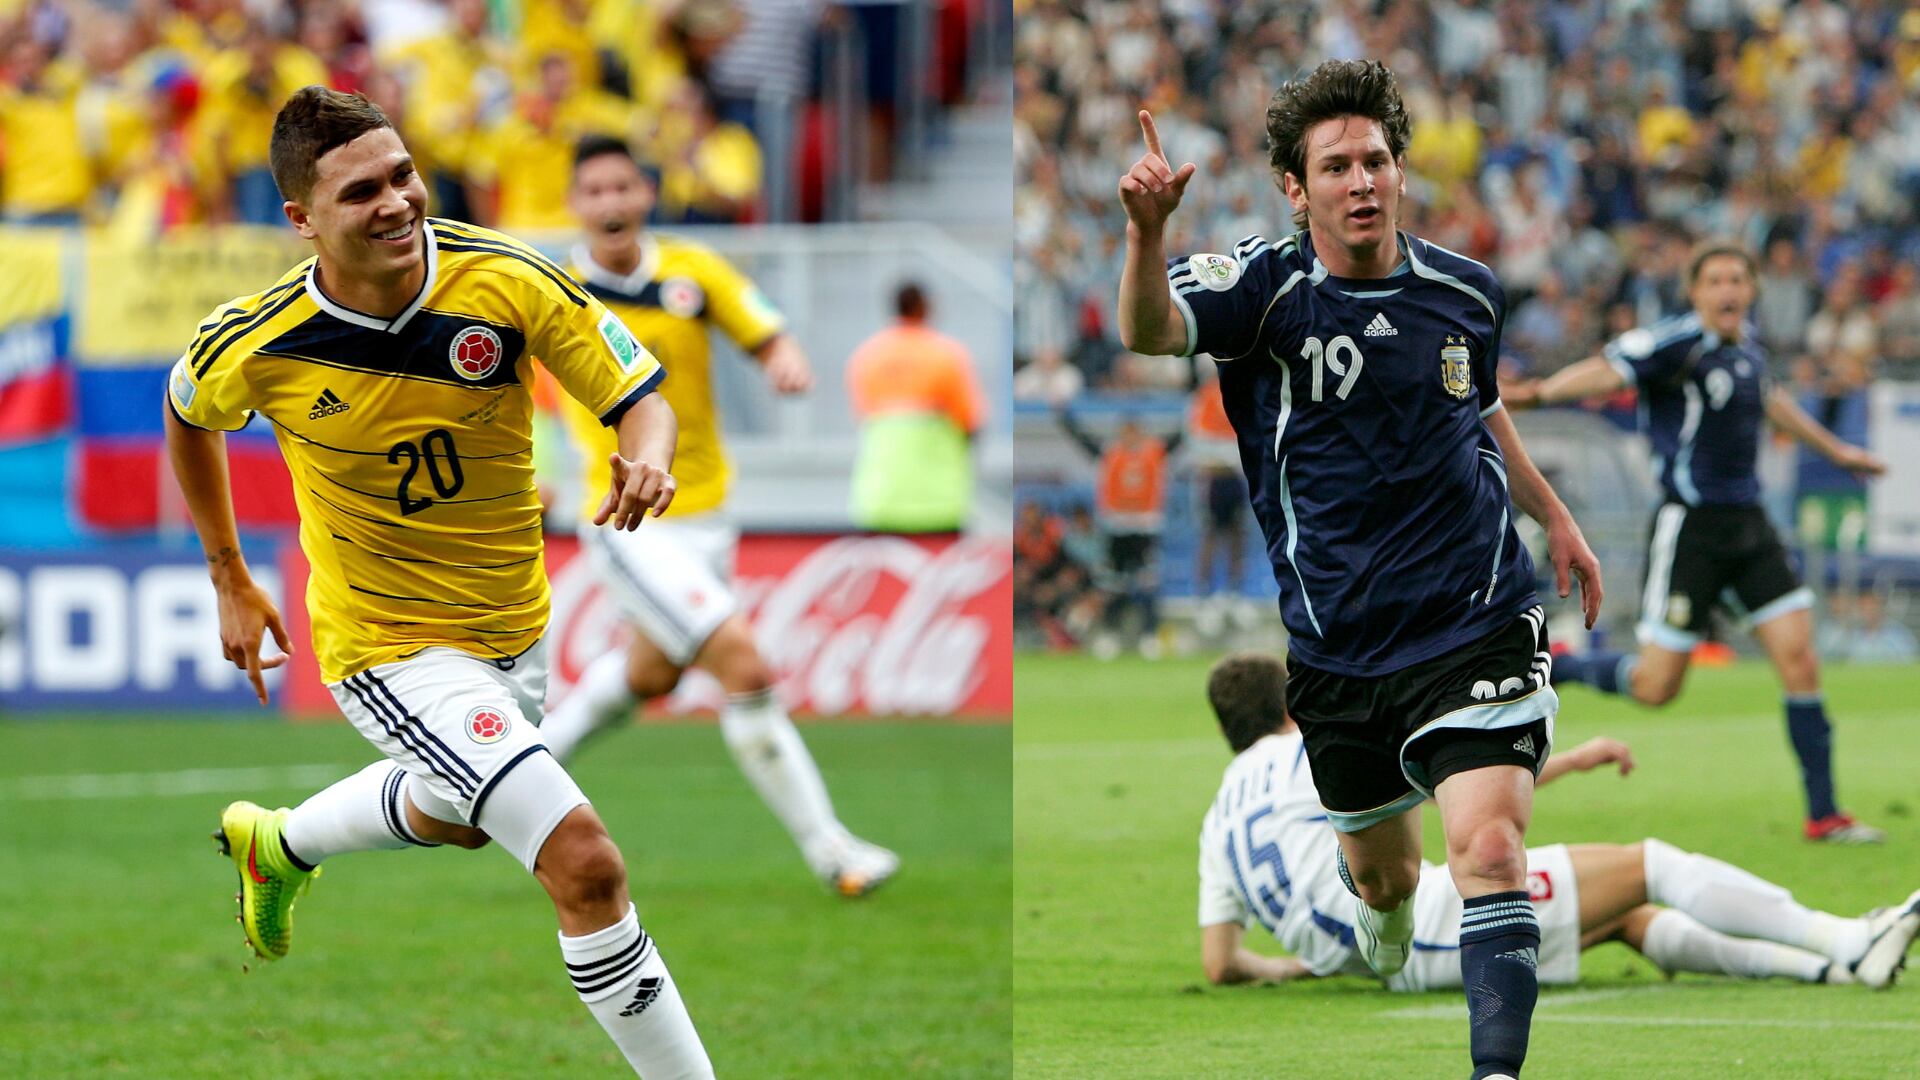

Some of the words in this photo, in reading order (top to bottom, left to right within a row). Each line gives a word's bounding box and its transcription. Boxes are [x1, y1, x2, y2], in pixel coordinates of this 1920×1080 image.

[1364, 328, 1399, 337] adidas
[1300, 335, 1364, 402] 19
[1705, 367, 1734, 411] 9
[308, 402, 350, 421] adidas
[388, 429, 464, 516] 20
[1226, 803, 1292, 932] 15
